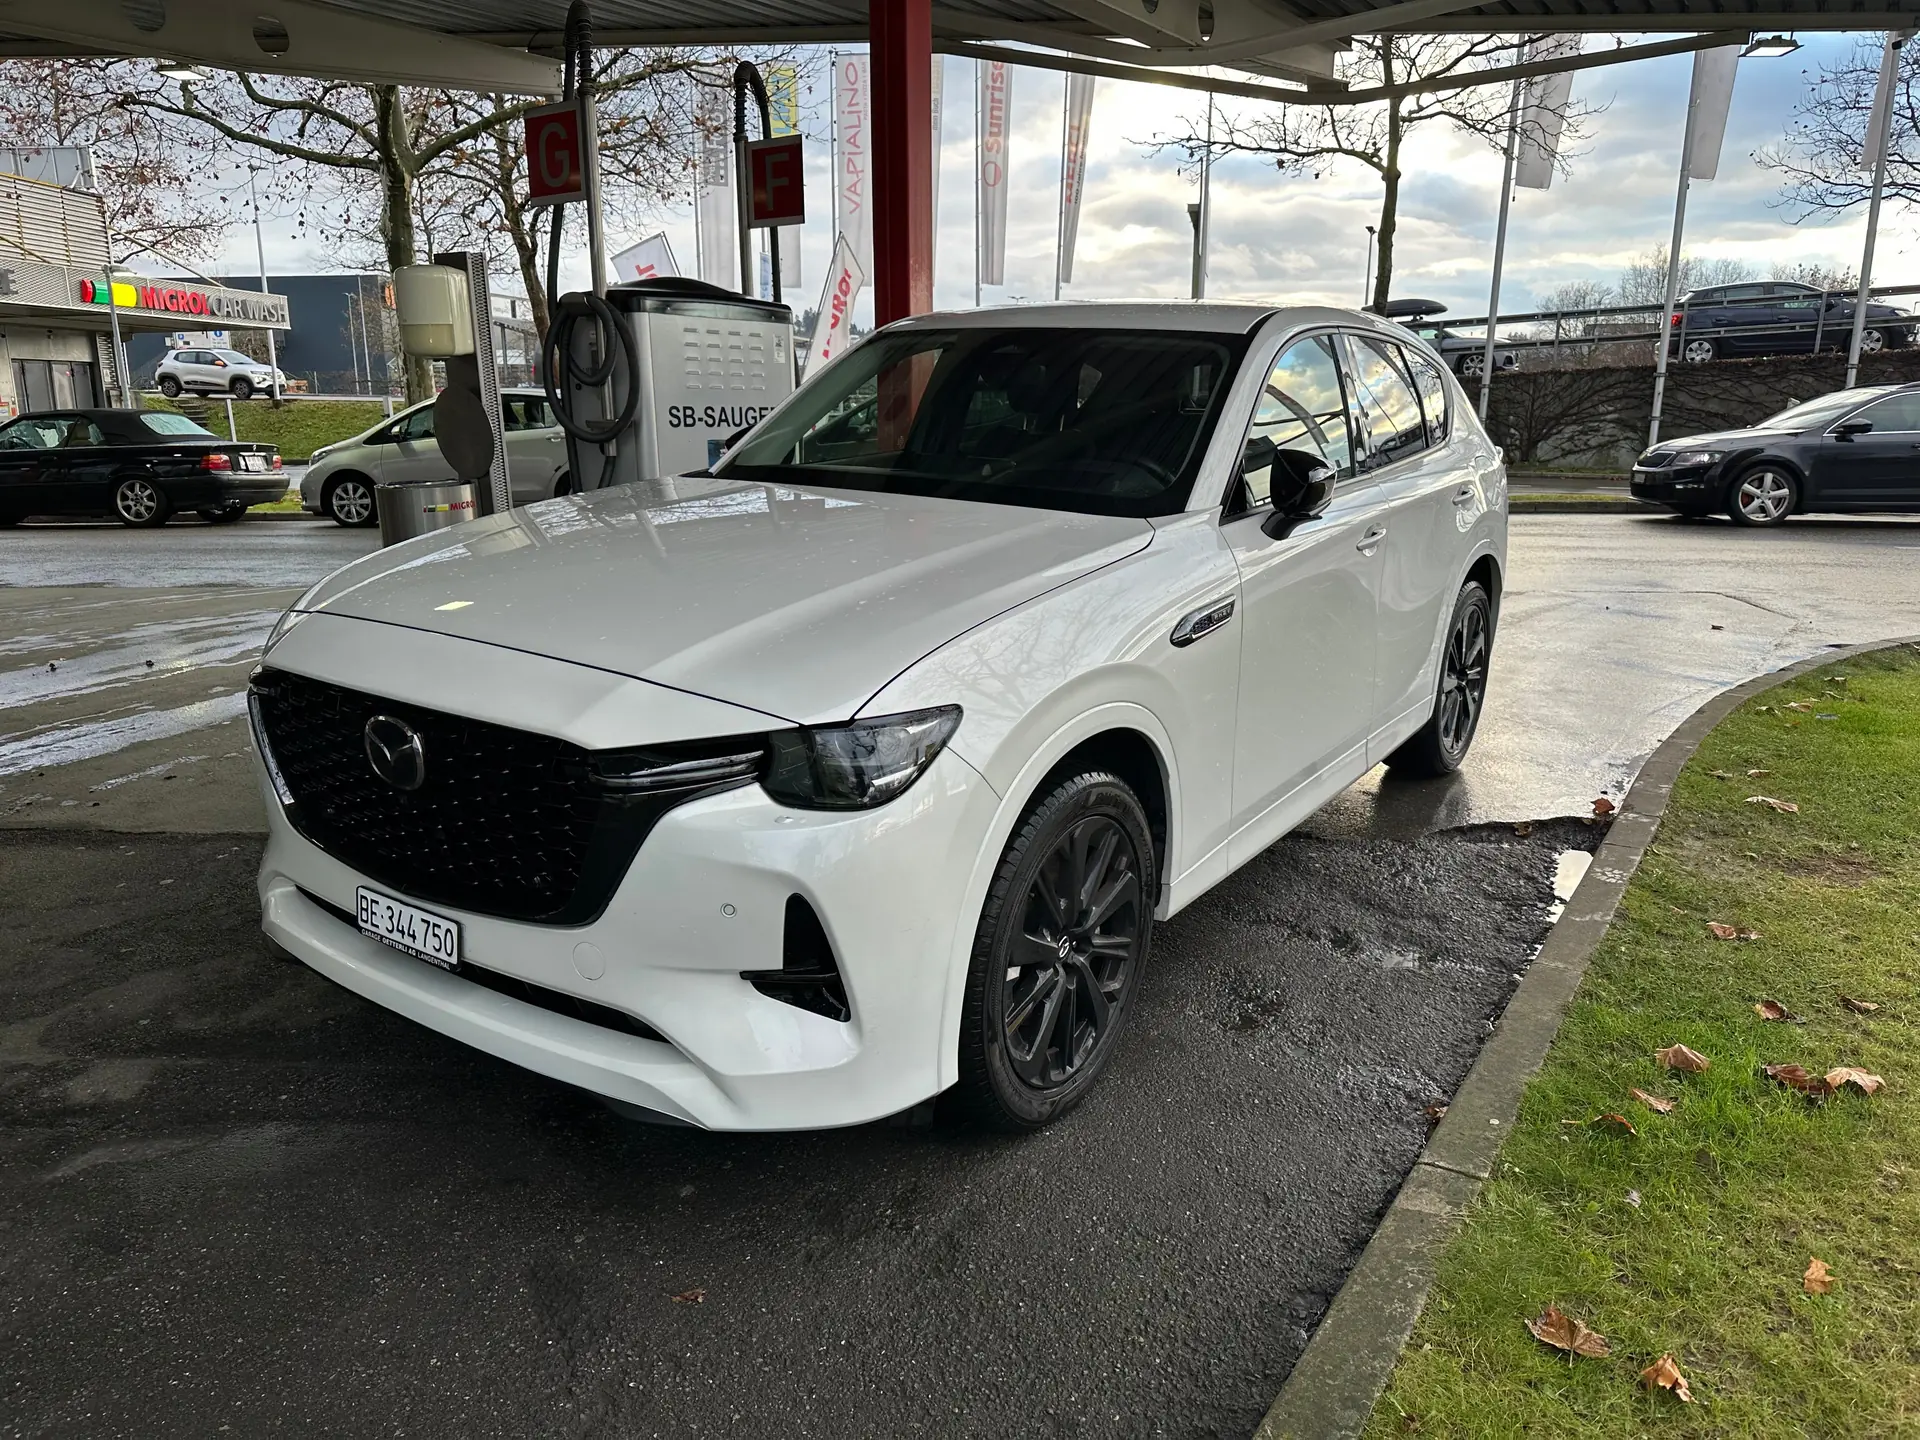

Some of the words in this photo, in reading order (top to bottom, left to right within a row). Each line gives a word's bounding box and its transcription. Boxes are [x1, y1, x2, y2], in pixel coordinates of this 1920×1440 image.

[538, 121, 570, 188] G
[765, 152, 790, 212] F
[140, 285, 210, 315] MIGROL
[211, 295, 243, 318] CAR
[248, 299, 287, 323] WASH
[668, 405, 776, 428] SB-SAUGE
[361, 928, 381, 942] GARAGE
[382, 936, 408, 953] OETTERLI
[408, 948, 416, 956] AG
[417, 951, 451, 971] LANGENTHAL
